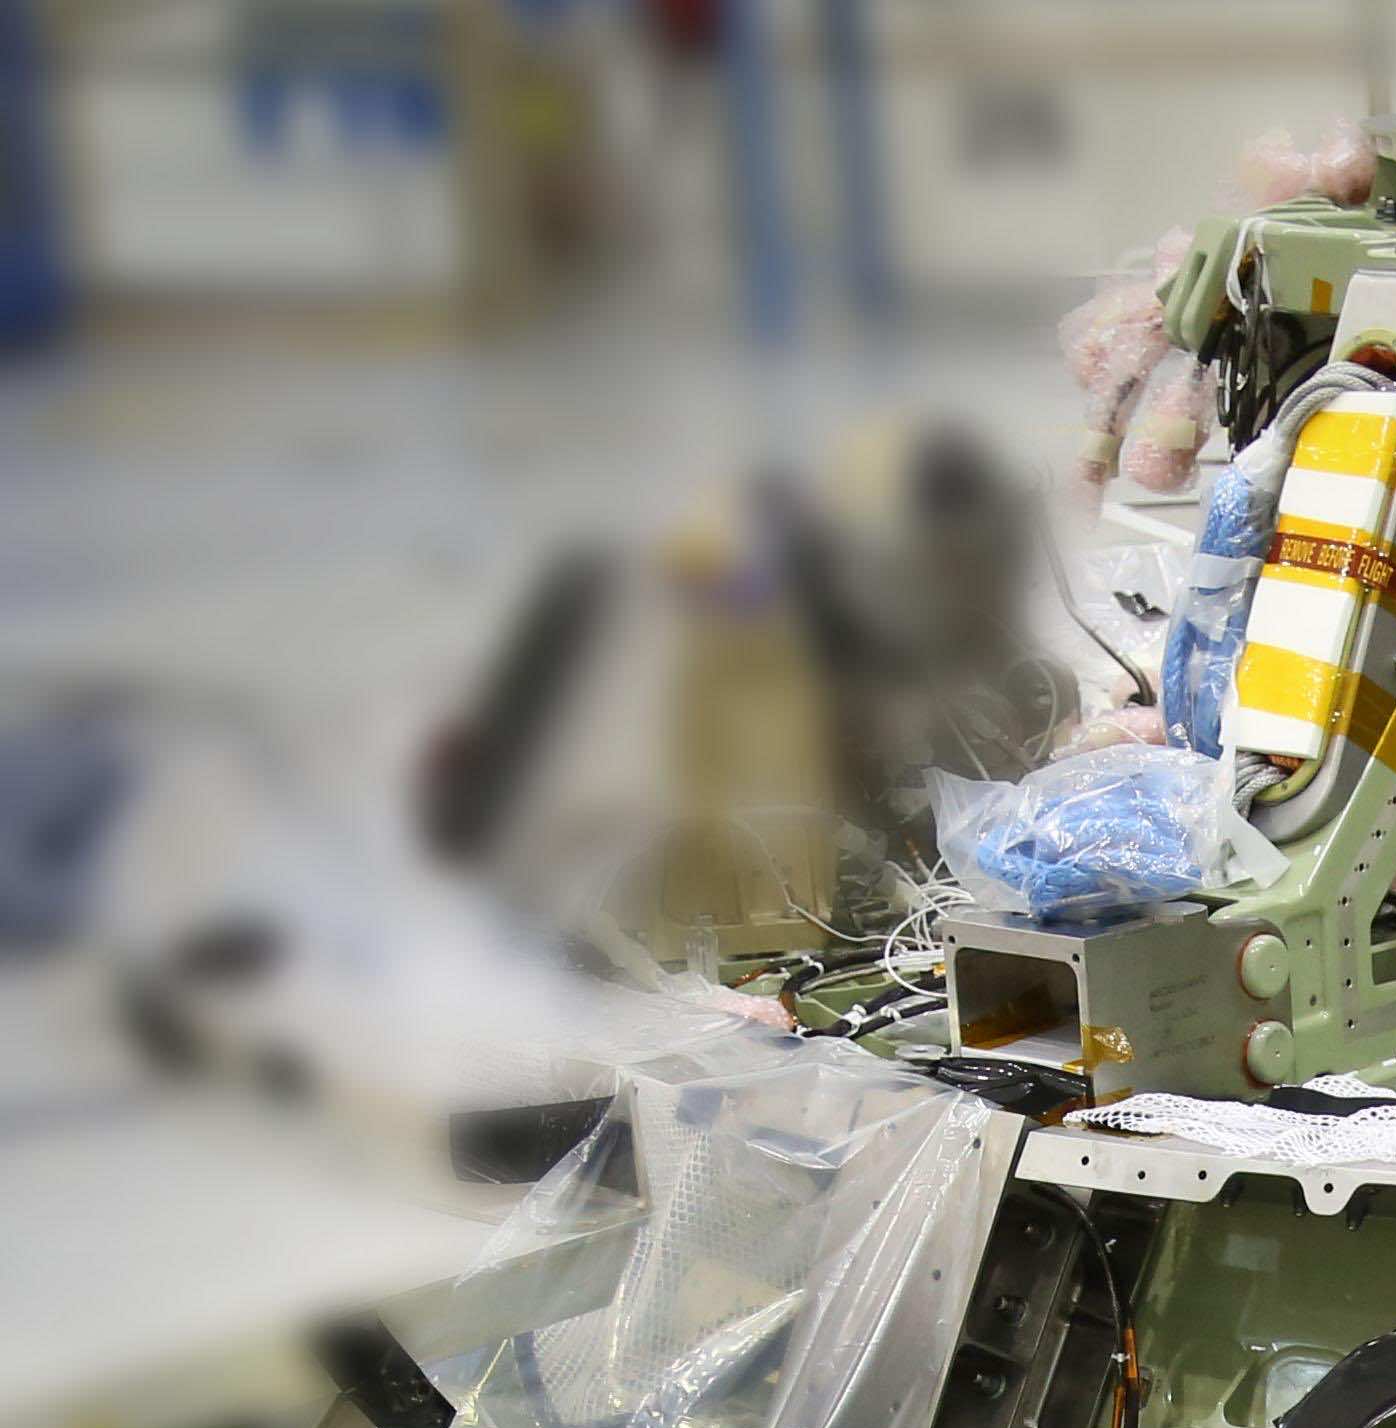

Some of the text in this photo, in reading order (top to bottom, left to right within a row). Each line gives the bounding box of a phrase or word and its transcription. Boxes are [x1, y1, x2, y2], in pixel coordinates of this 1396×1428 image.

[1280, 538, 1394, 588] REMOVE BEFORE FLIGHT
